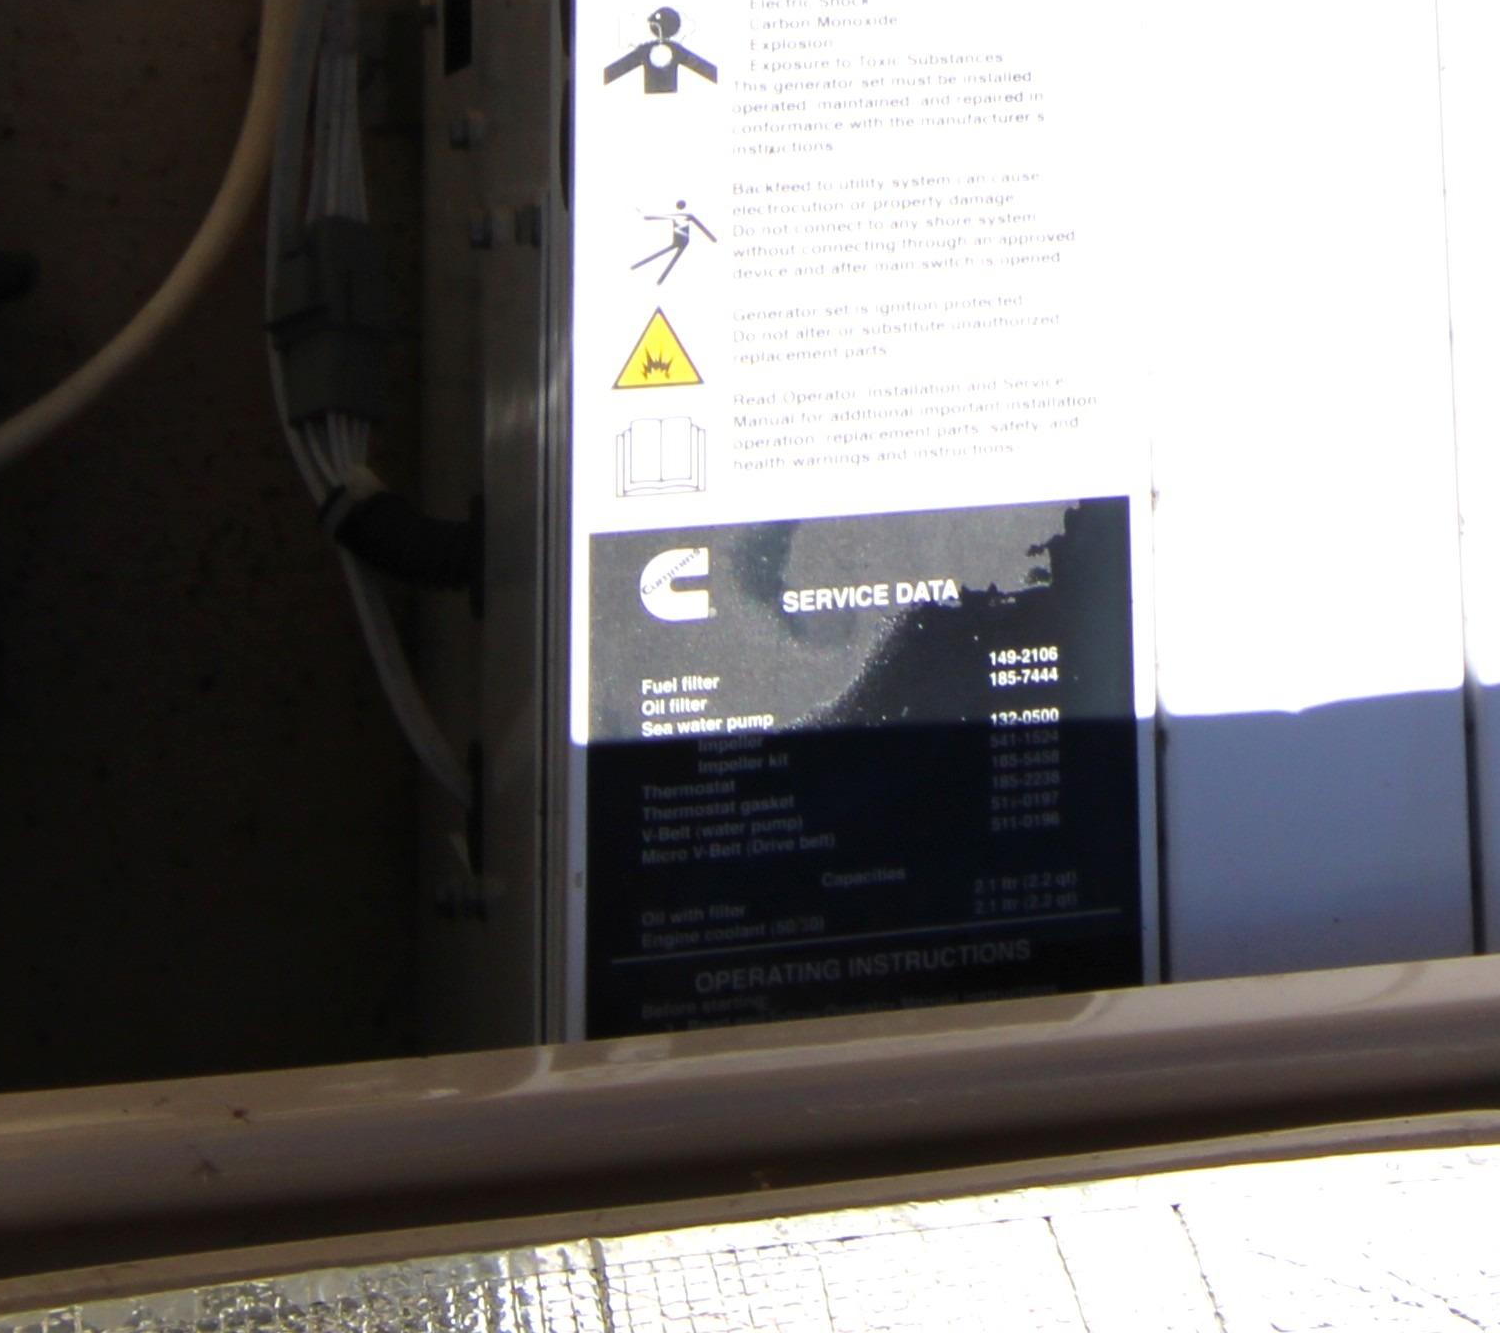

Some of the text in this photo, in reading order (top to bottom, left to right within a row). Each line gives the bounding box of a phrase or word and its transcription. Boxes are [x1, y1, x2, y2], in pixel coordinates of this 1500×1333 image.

[749, 14, 899, 28] Carbon Monoxide
[749, 38, 836, 53] Explosion
[749, 58, 832, 74] Exposure
[835, 57, 853, 69] to
[907, 53, 1006, 67] Substances
[734, 80, 769, 92] This
[773, 77, 855, 93] generator
[860, 76, 887, 88] set
[890, 74, 933, 87] must
[937, 74, 959, 86] be
[920, 94, 952, 107] and
[956, 92, 1026, 108] repaired
[731, 119, 845, 134] conformance
[849, 118, 885, 130] with
[889, 117, 916, 129] the
[732, 180, 813, 194] Backfeed
[838, 177, 885, 193] utility
[891, 175, 952, 191] system
[991, 173, 1043, 184] cause
[732, 200, 845, 215] electrocution
[850, 201, 868, 211] or
[873, 197, 943, 213] property
[732, 224, 757, 236] Do
[762, 223, 789, 235] not
[794, 219, 863, 233] connect
[868, 218, 885, 230] to
[889, 218, 919, 232] any
[926, 214, 973, 227] shore
[732, 230, 1077, 256] without connecting through an approved
[732, 265, 790, 279] device
[794, 263, 827, 276] and
[831, 261, 869, 274] after
[875, 259, 917, 272] main
[921, 256, 975, 269] switch
[732, 306, 819, 321] Generator
[824, 304, 851, 316] set
[874, 299, 940, 315] ignition
[732, 330, 758, 342] Do
[762, 328, 790, 341] not
[795, 326, 833, 339] alter
[861, 320, 947, 335] substitute
[732, 348, 841, 365] replacement
[732, 392, 777, 405] Read
[966, 379, 998, 392] and
[733, 413, 796, 427] Manual
[801, 411, 824, 423] for
[830, 406, 914, 421] additional
[919, 400, 1000, 418] important
[826, 425, 932, 444] replacement
[1048, 416, 1080, 429] and
[733, 456, 788, 470] health
[792, 451, 872, 468] warnings
[876, 449, 908, 462] and
[783, 579, 958, 612] SERVICE DATA
[989, 647, 1059, 666] 149-2106
[641, 675, 720, 696] Fuel filter
[989, 667, 1059, 687] 185-7444
[642, 697, 708, 716] Oil filter
[990, 707, 1060, 725] 132-0500
[641, 714, 774, 737] Sea water pump
[698, 735, 764, 754] Impeller
[698, 753, 789, 775] Impeller kit
[643, 780, 736, 800] Thermostat
[643, 795, 796, 821] Thermostat gasket
[643, 826, 691, 842] V-Belt
[751, 815, 804, 836] pump)
[643, 847, 688, 865] Micro
[694, 842, 742, 859] V-Belt
[821, 866, 906, 887] Capacities
[670, 909, 704, 924] with
[695, 938, 1030, 995] OPERATING INSTRUCTIONS
